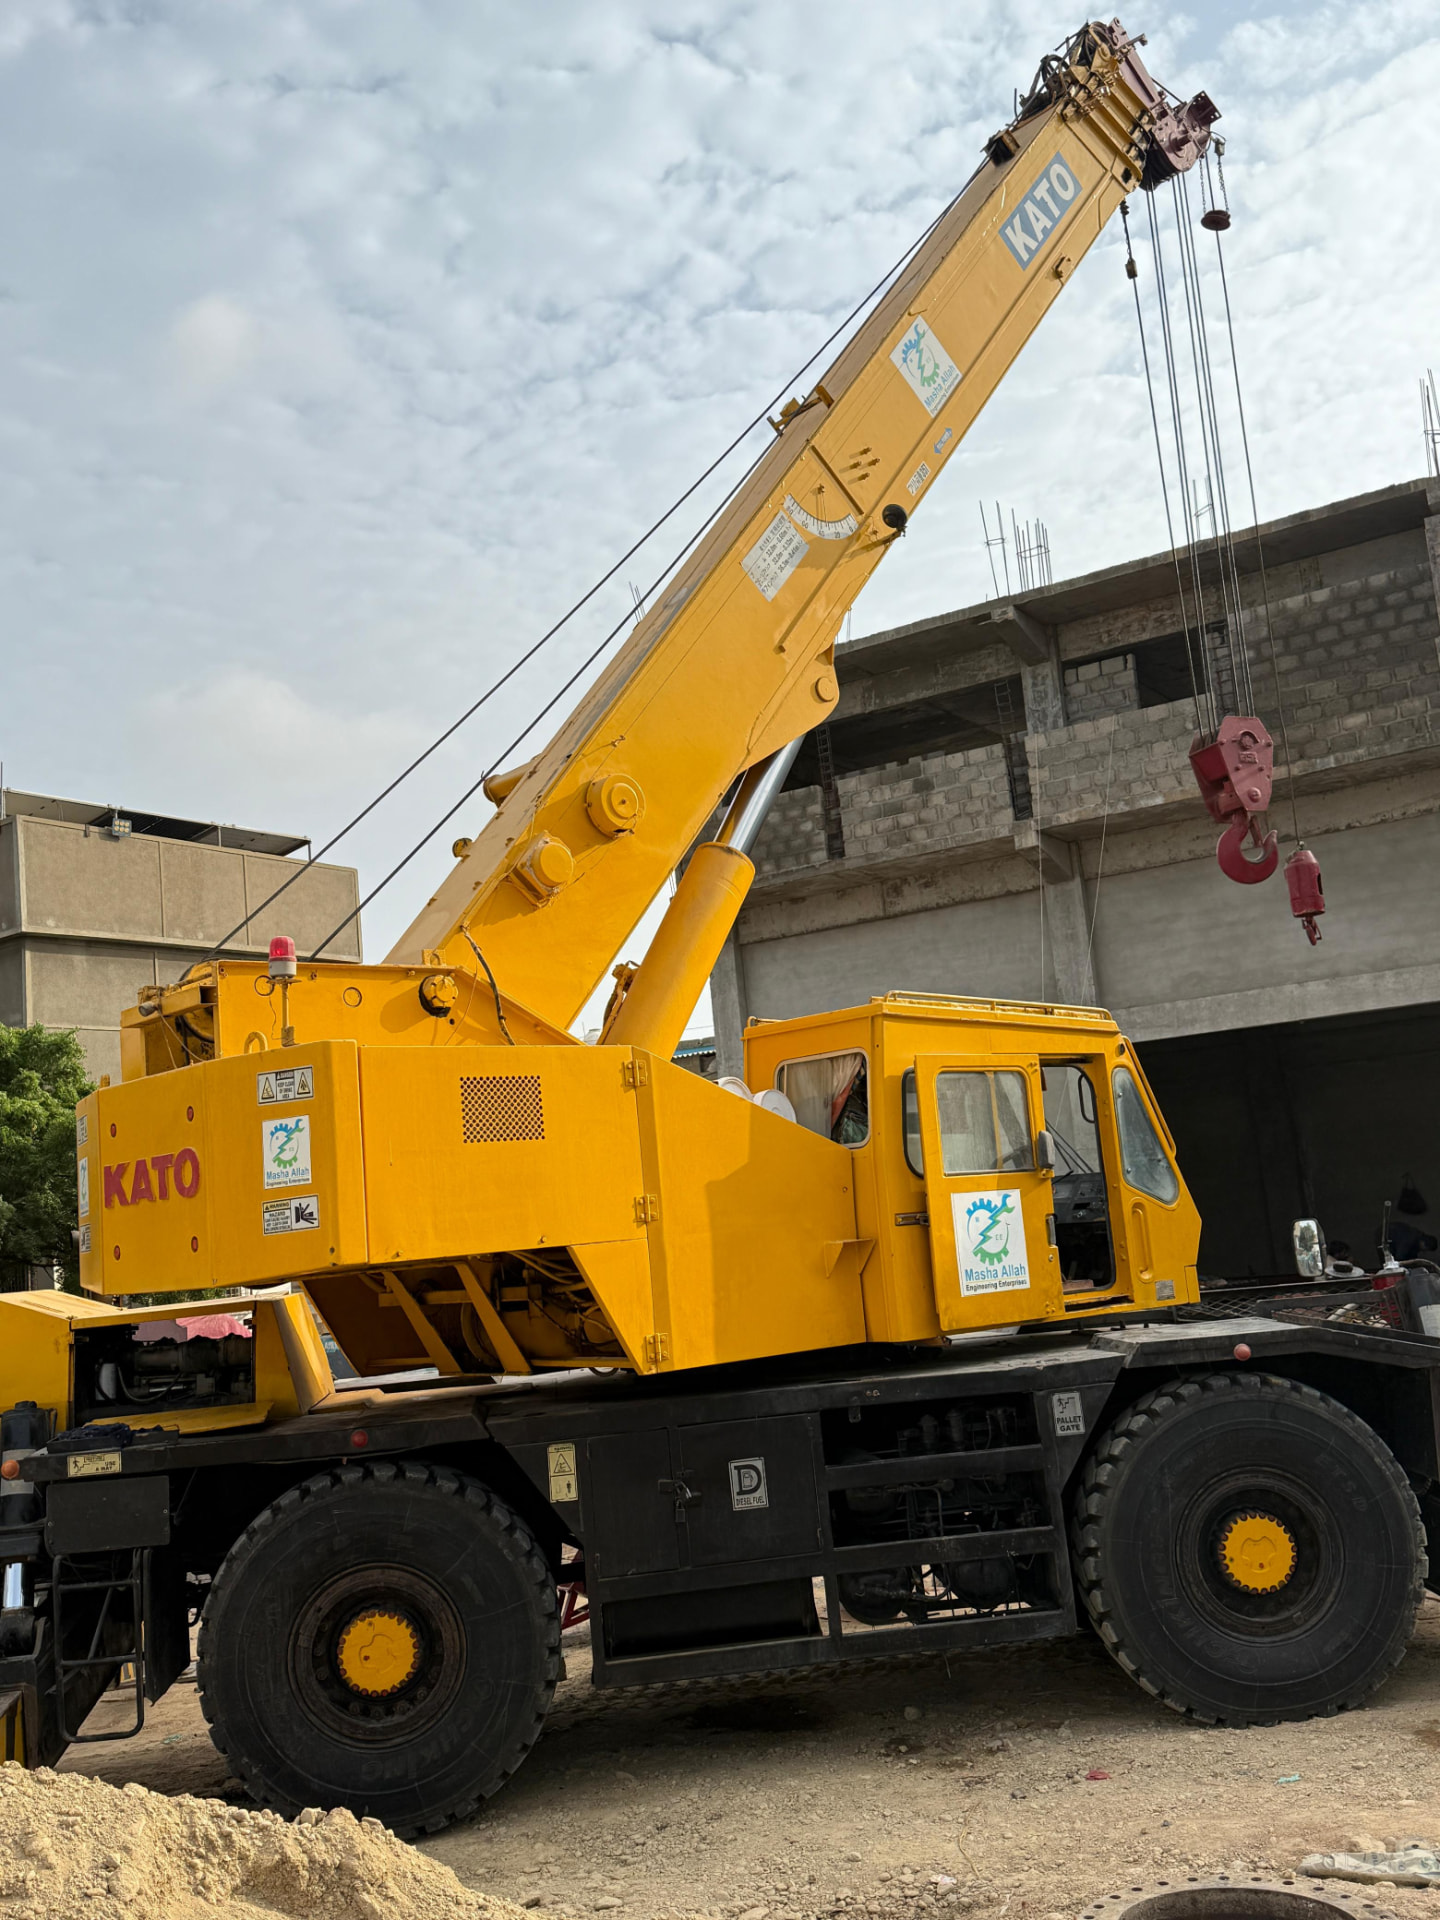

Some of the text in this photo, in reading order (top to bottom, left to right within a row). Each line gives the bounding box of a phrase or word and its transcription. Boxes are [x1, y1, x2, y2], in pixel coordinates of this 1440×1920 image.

[1004, 163, 1075, 262] KATO
[924, 364, 956, 408] Masha Allah
[103, 1147, 200, 1209] KATO
[266, 1167, 310, 1180] Masha Allah
[964, 1263, 1026, 1282] Masha Allah
[965, 1279, 1027, 1292] Engineering Enterprises
[1056, 1415, 1081, 1424] PALLET
[1060, 1424, 1080, 1432] GATE
[733, 1463, 762, 1496] D
[735, 1496, 765, 1506] DIESEL FUEL
